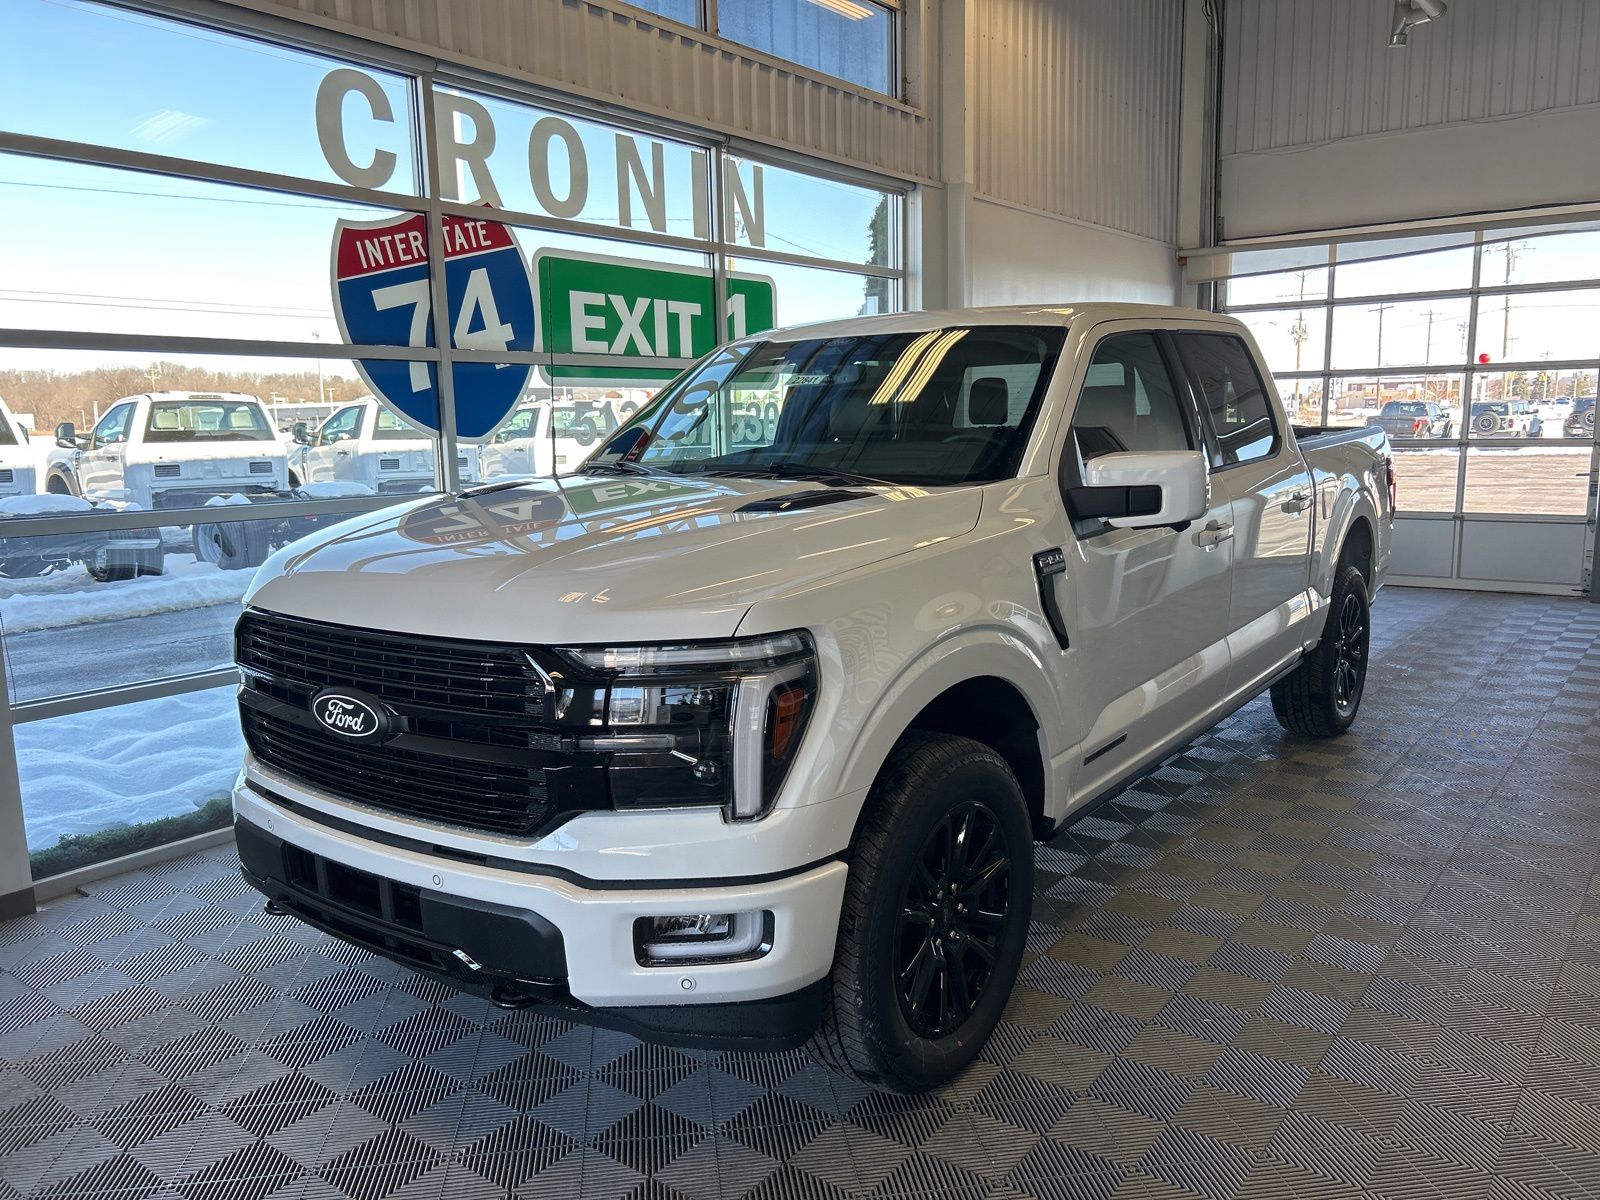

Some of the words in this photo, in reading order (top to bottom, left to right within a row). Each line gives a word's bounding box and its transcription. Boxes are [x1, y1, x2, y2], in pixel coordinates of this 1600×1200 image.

[315, 68, 765, 248] CRONIN
[356, 221, 492, 269] INTERTATE
[371, 267, 515, 393] 74
[569, 290, 702, 359] EXIT
[727, 293, 747, 341] 1
[325, 699, 365, 731] Ford
